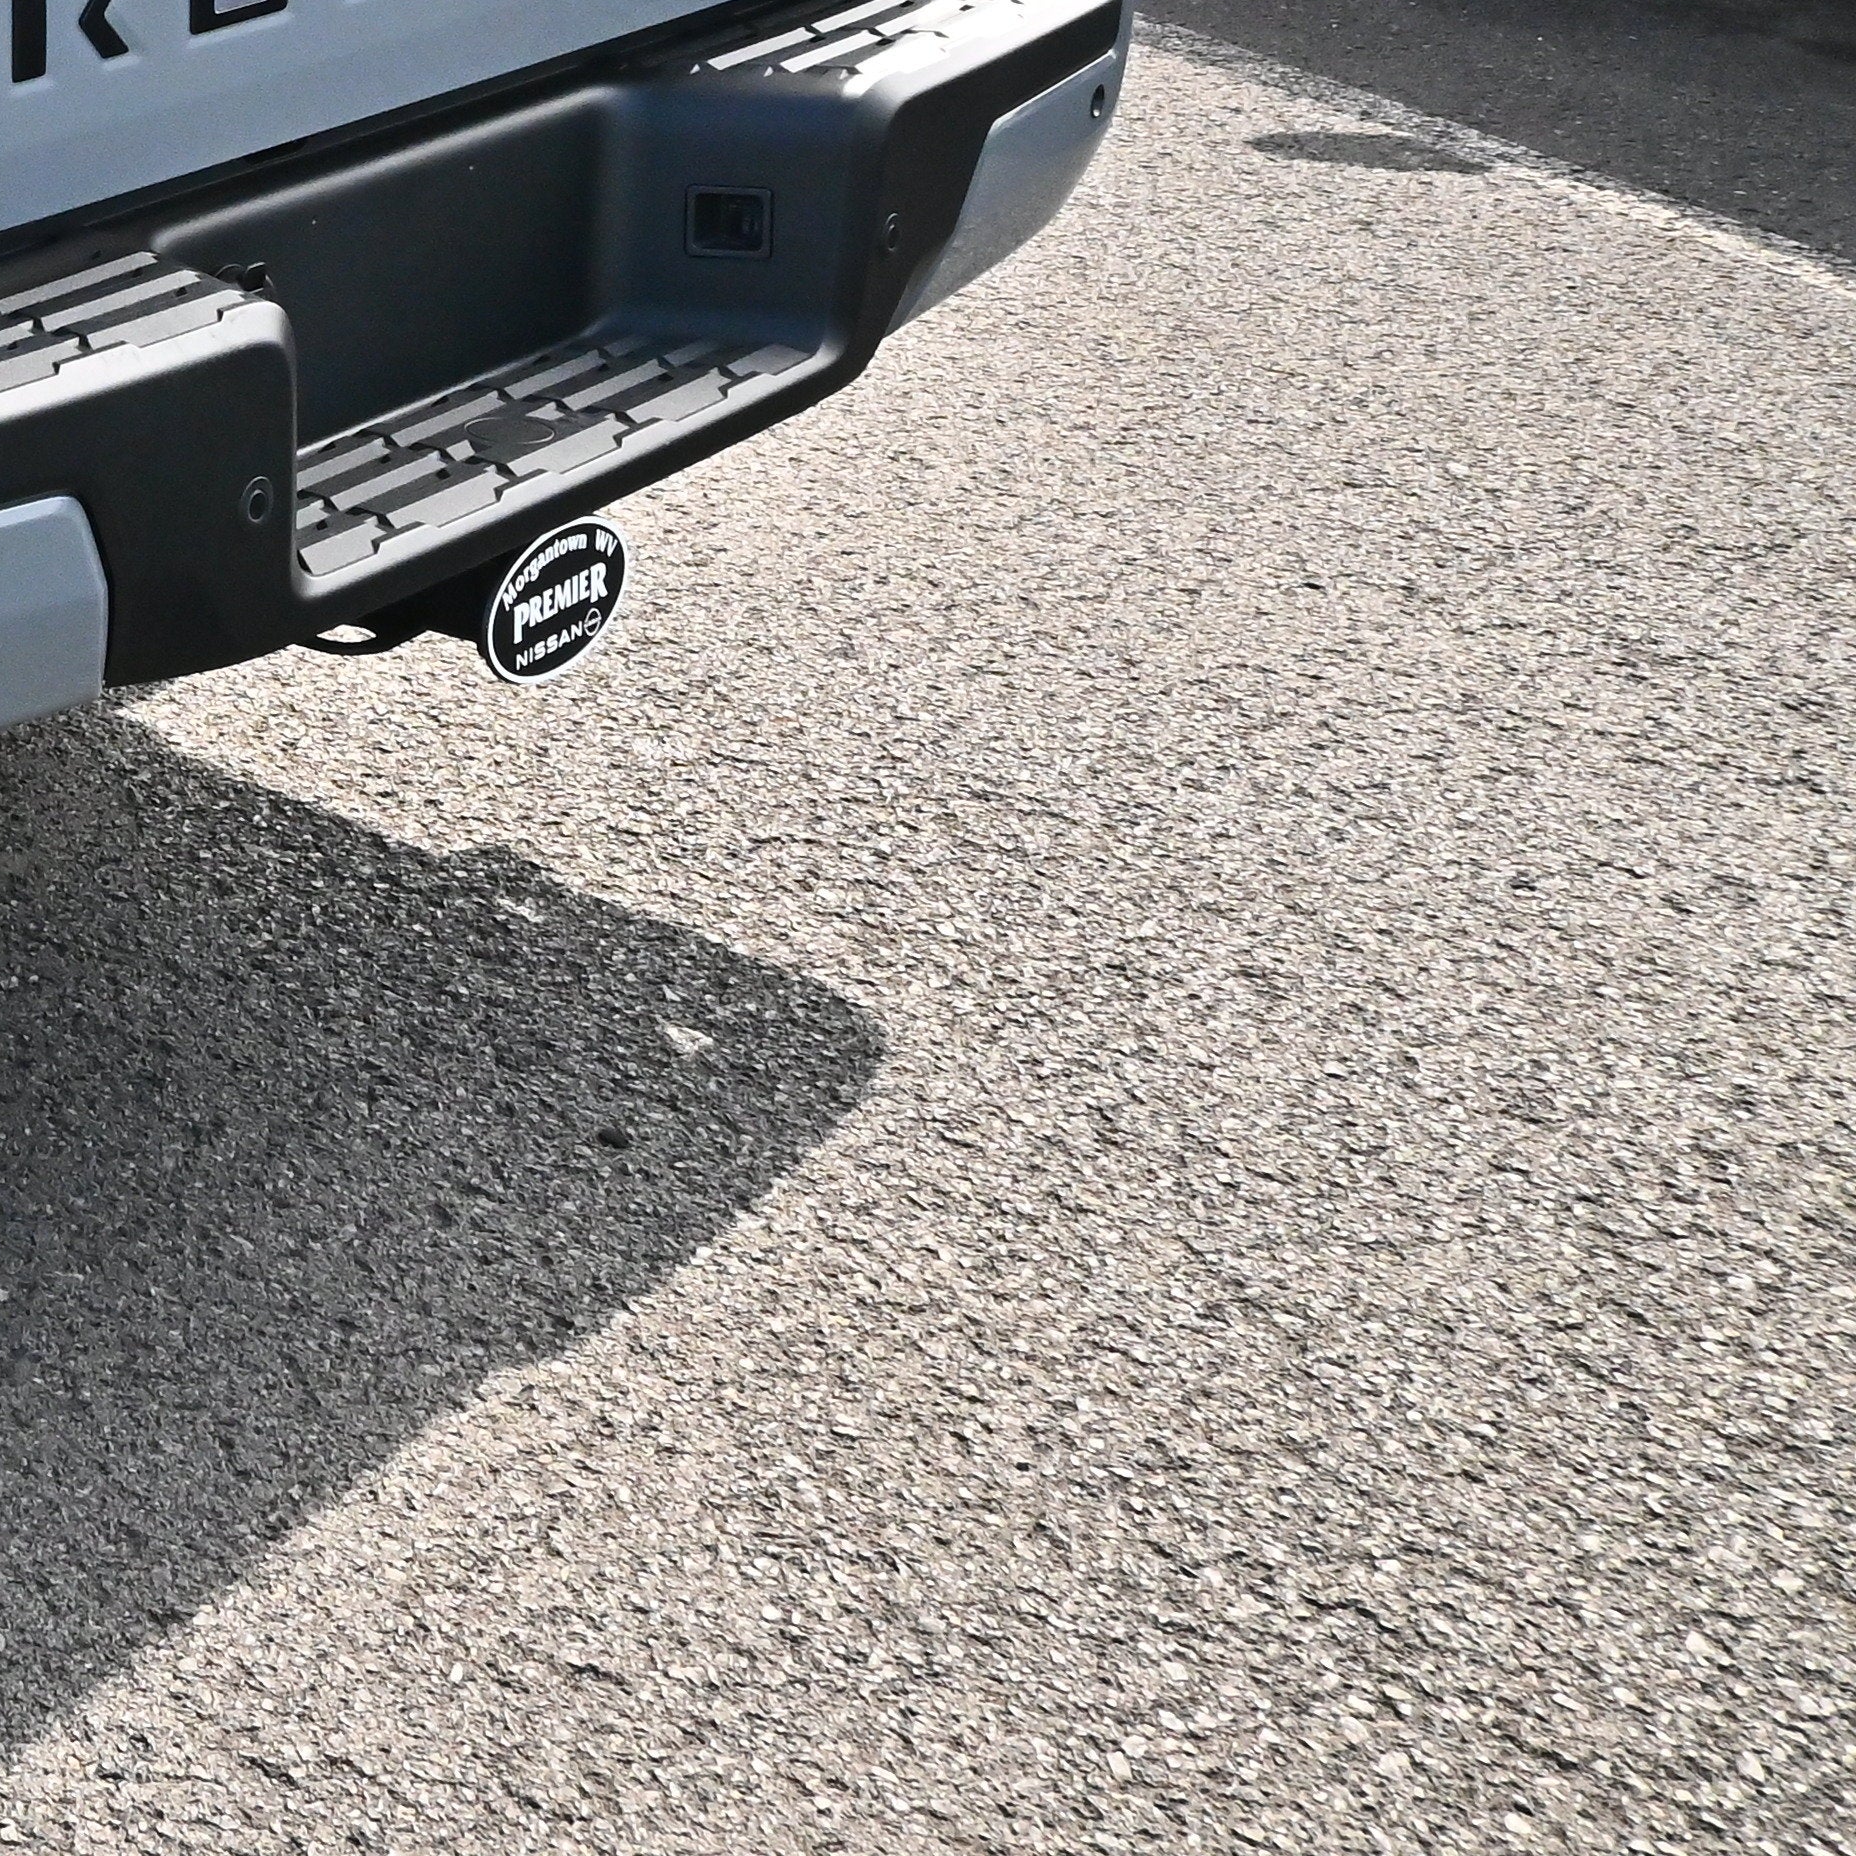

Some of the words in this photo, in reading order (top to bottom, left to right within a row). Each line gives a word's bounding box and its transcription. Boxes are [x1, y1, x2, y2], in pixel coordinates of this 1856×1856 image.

[501, 533, 588, 611] Morgantown
[594, 528, 618, 558] WV
[513, 562, 608, 644] PREMIER
[516, 620, 583, 670] NISSAN
